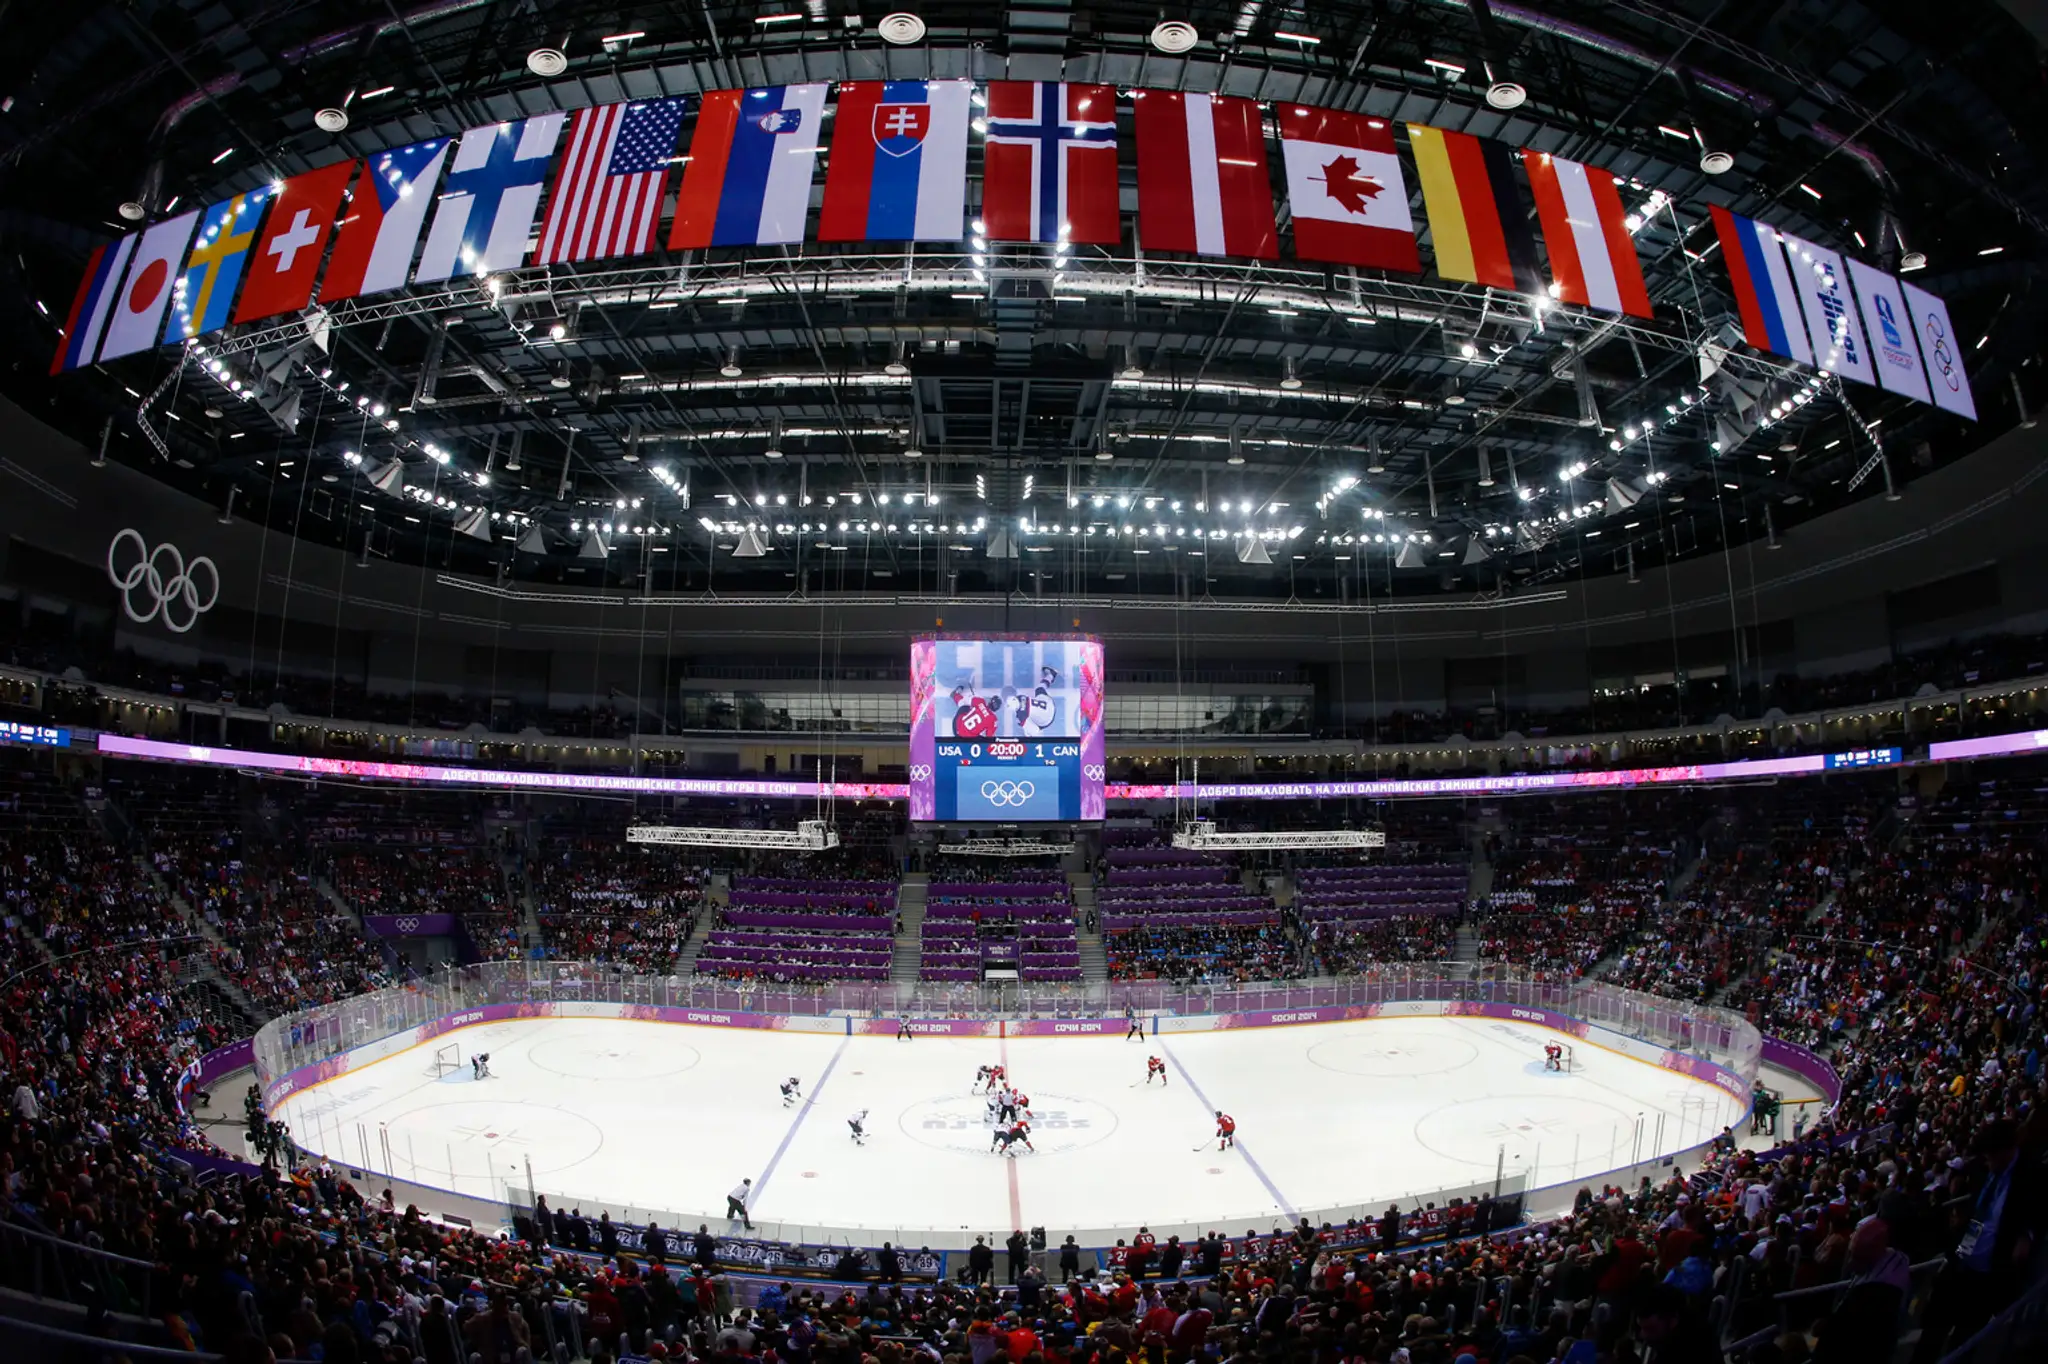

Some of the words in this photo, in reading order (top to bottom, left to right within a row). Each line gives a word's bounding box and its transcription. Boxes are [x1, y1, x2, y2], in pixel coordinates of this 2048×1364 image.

[938, 745, 963, 757] USA
[970, 743, 981, 758] 0
[990, 743, 1024, 756] 20:00
[1035, 743, 1045, 758] 1
[1052, 745, 1079, 756] CAN
[442, 770, 478, 783] ДОБРО
[481, 771, 553, 784] ПОЖАЛОВАТЬ
[556, 776, 571, 786] НА
[769, 785, 797, 794] СОЧИ
[1198, 785, 1236, 798] ДОБРО
[1240, 784, 1312, 796] ПОЖАЛОВАТЬ
[1315, 784, 1330, 794] НА
[1358, 781, 1436, 793] ОЛИМПИЙСКИЕ
[1271, 1013, 1296, 1023] SOCHI
[929, 1023, 951, 1033] 2014
[1055, 1023, 1079, 1032] СОЧИ
[1080, 1023, 1102, 1032] 2014
